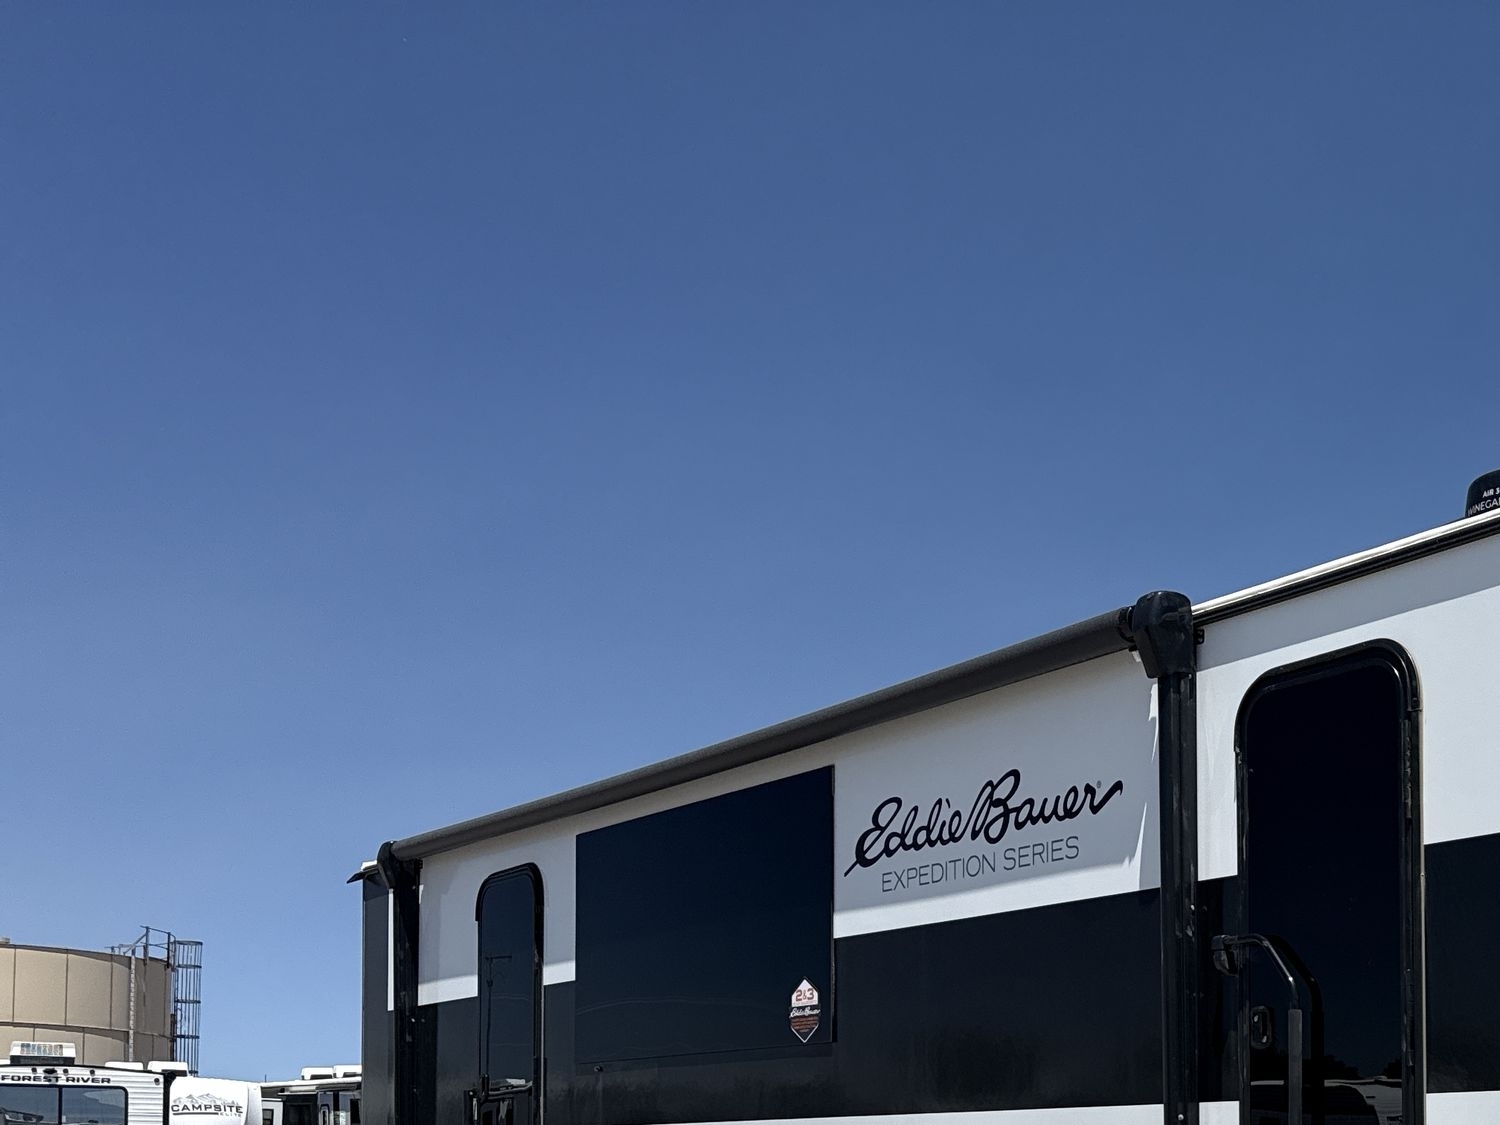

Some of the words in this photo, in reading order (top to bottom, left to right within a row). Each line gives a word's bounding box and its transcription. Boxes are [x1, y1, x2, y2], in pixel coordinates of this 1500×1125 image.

[1483, 489, 1494, 498] AIR
[844, 796, 970, 877] Eddie
[881, 852, 996, 893] EXPEDITION
[1003, 835, 1080, 872] SERIES
[1, 1075, 61, 1083] FOREST
[65, 1076, 111, 1084] RIVER
[171, 1104, 243, 1114] CAMPSITE
